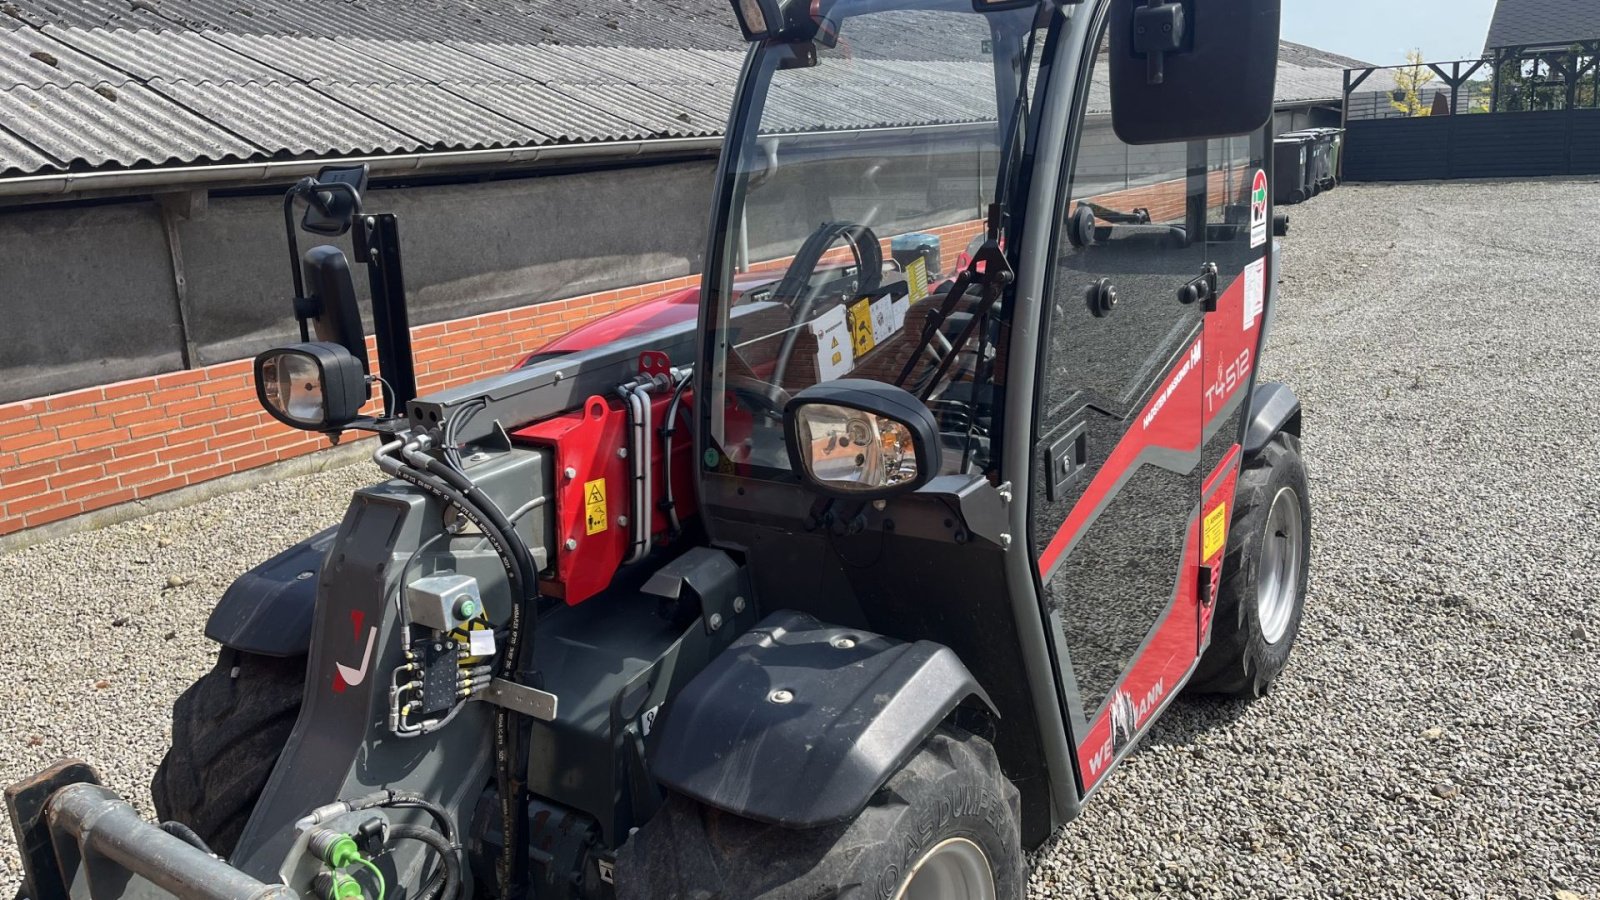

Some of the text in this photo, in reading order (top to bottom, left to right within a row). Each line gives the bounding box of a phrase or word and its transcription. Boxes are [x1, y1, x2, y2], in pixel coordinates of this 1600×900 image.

[1190, 339, 1201, 370] HM
[1205, 347, 1250, 412] T4512
[937, 785, 1007, 837] DUMPER
